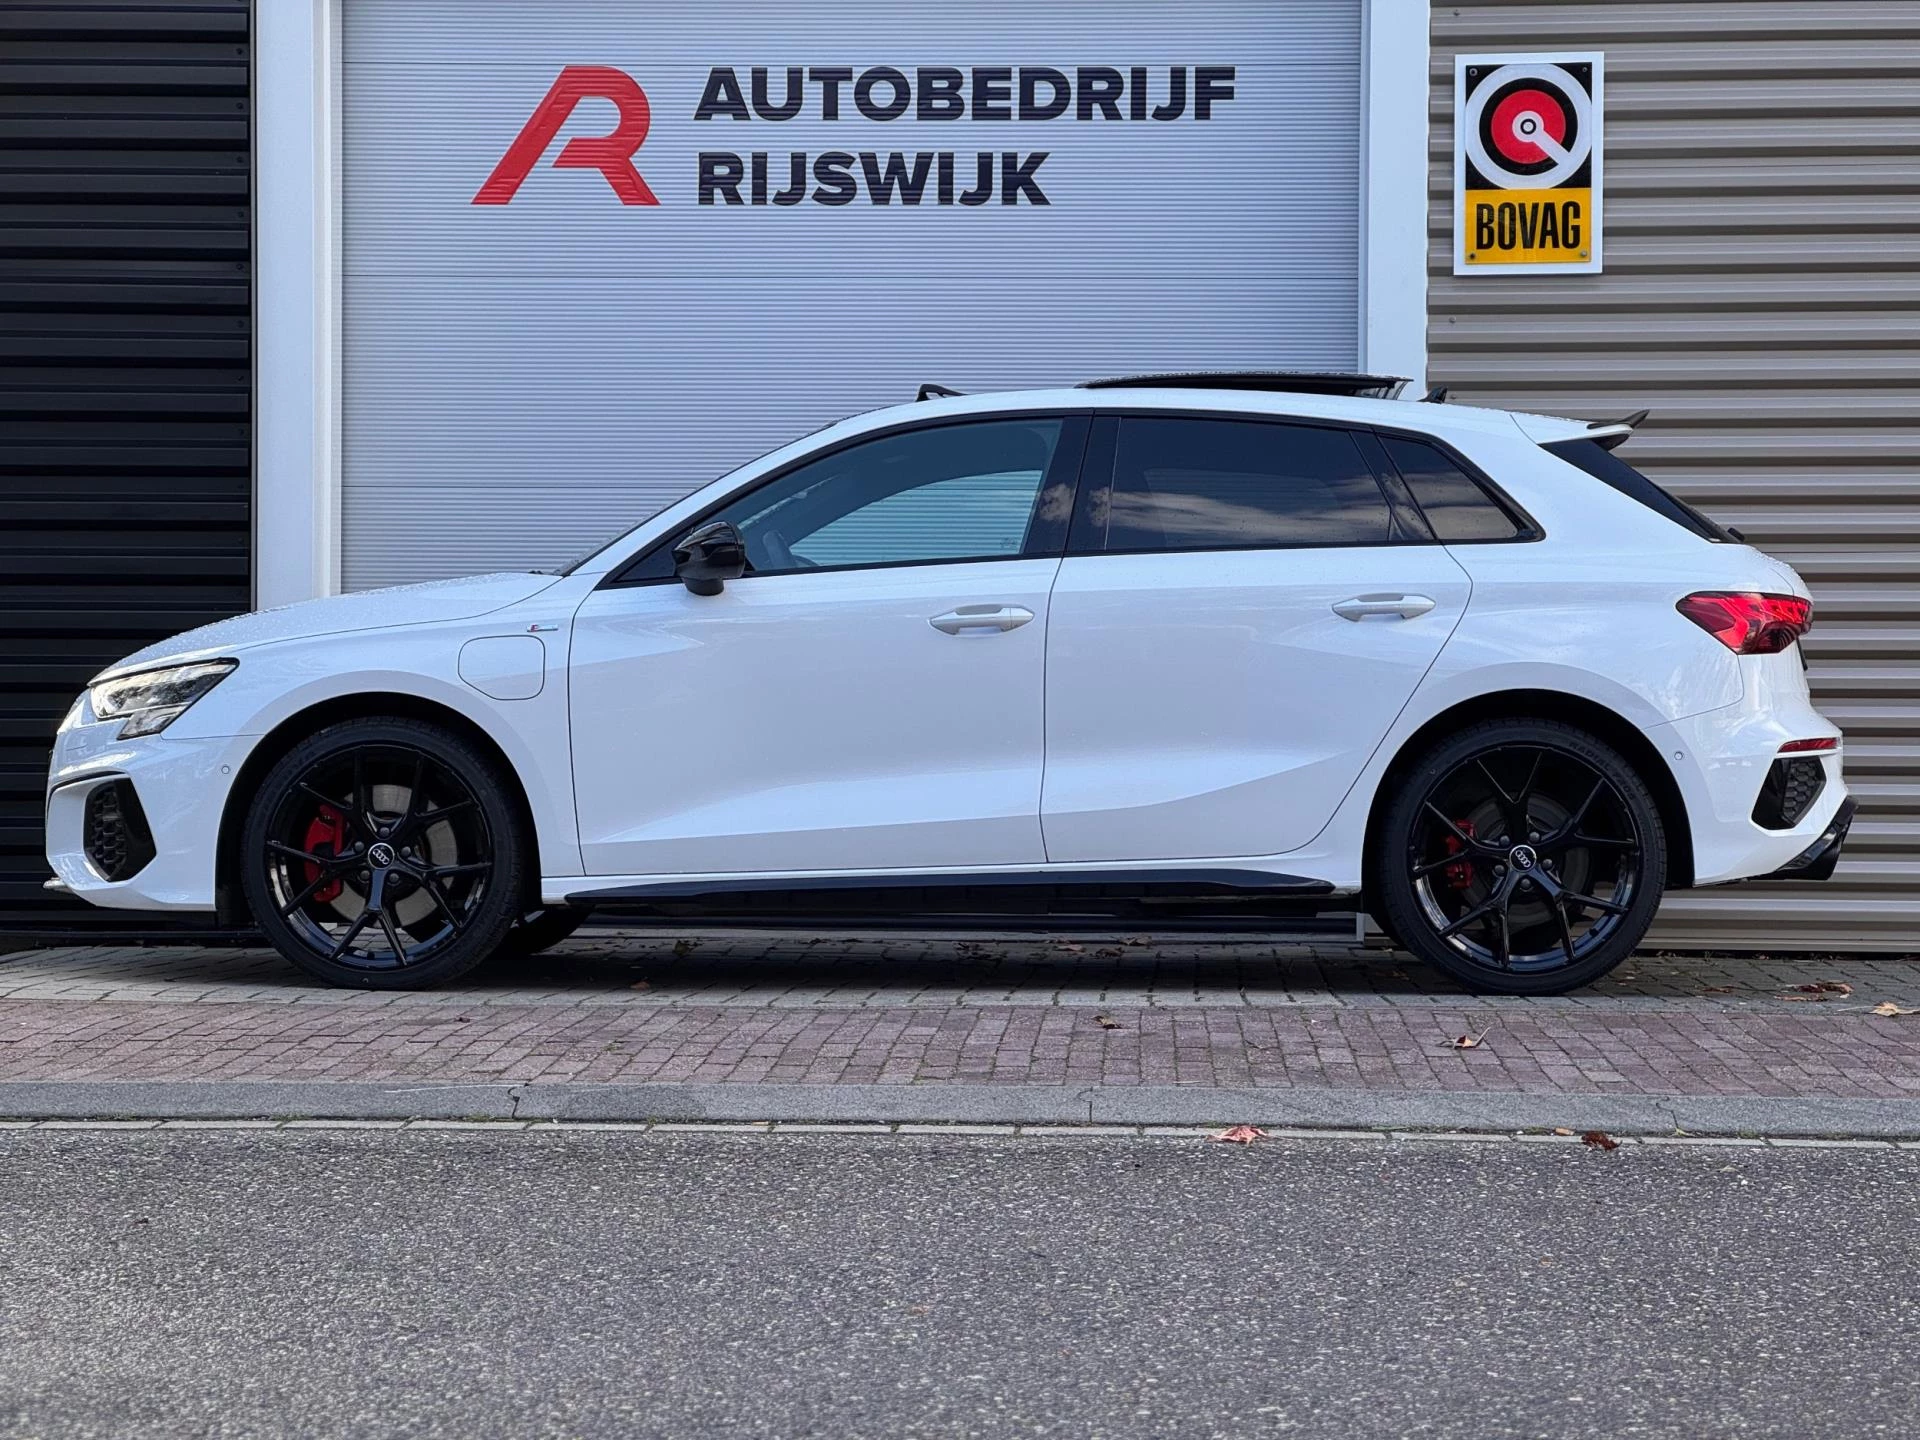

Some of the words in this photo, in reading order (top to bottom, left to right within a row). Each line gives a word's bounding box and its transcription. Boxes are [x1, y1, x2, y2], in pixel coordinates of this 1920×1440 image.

[694, 66, 1236, 122] AUTOBEDRIJF
[699, 151, 1051, 207] RIJSWIJK
[1476, 200, 1581, 250] BOVAG
